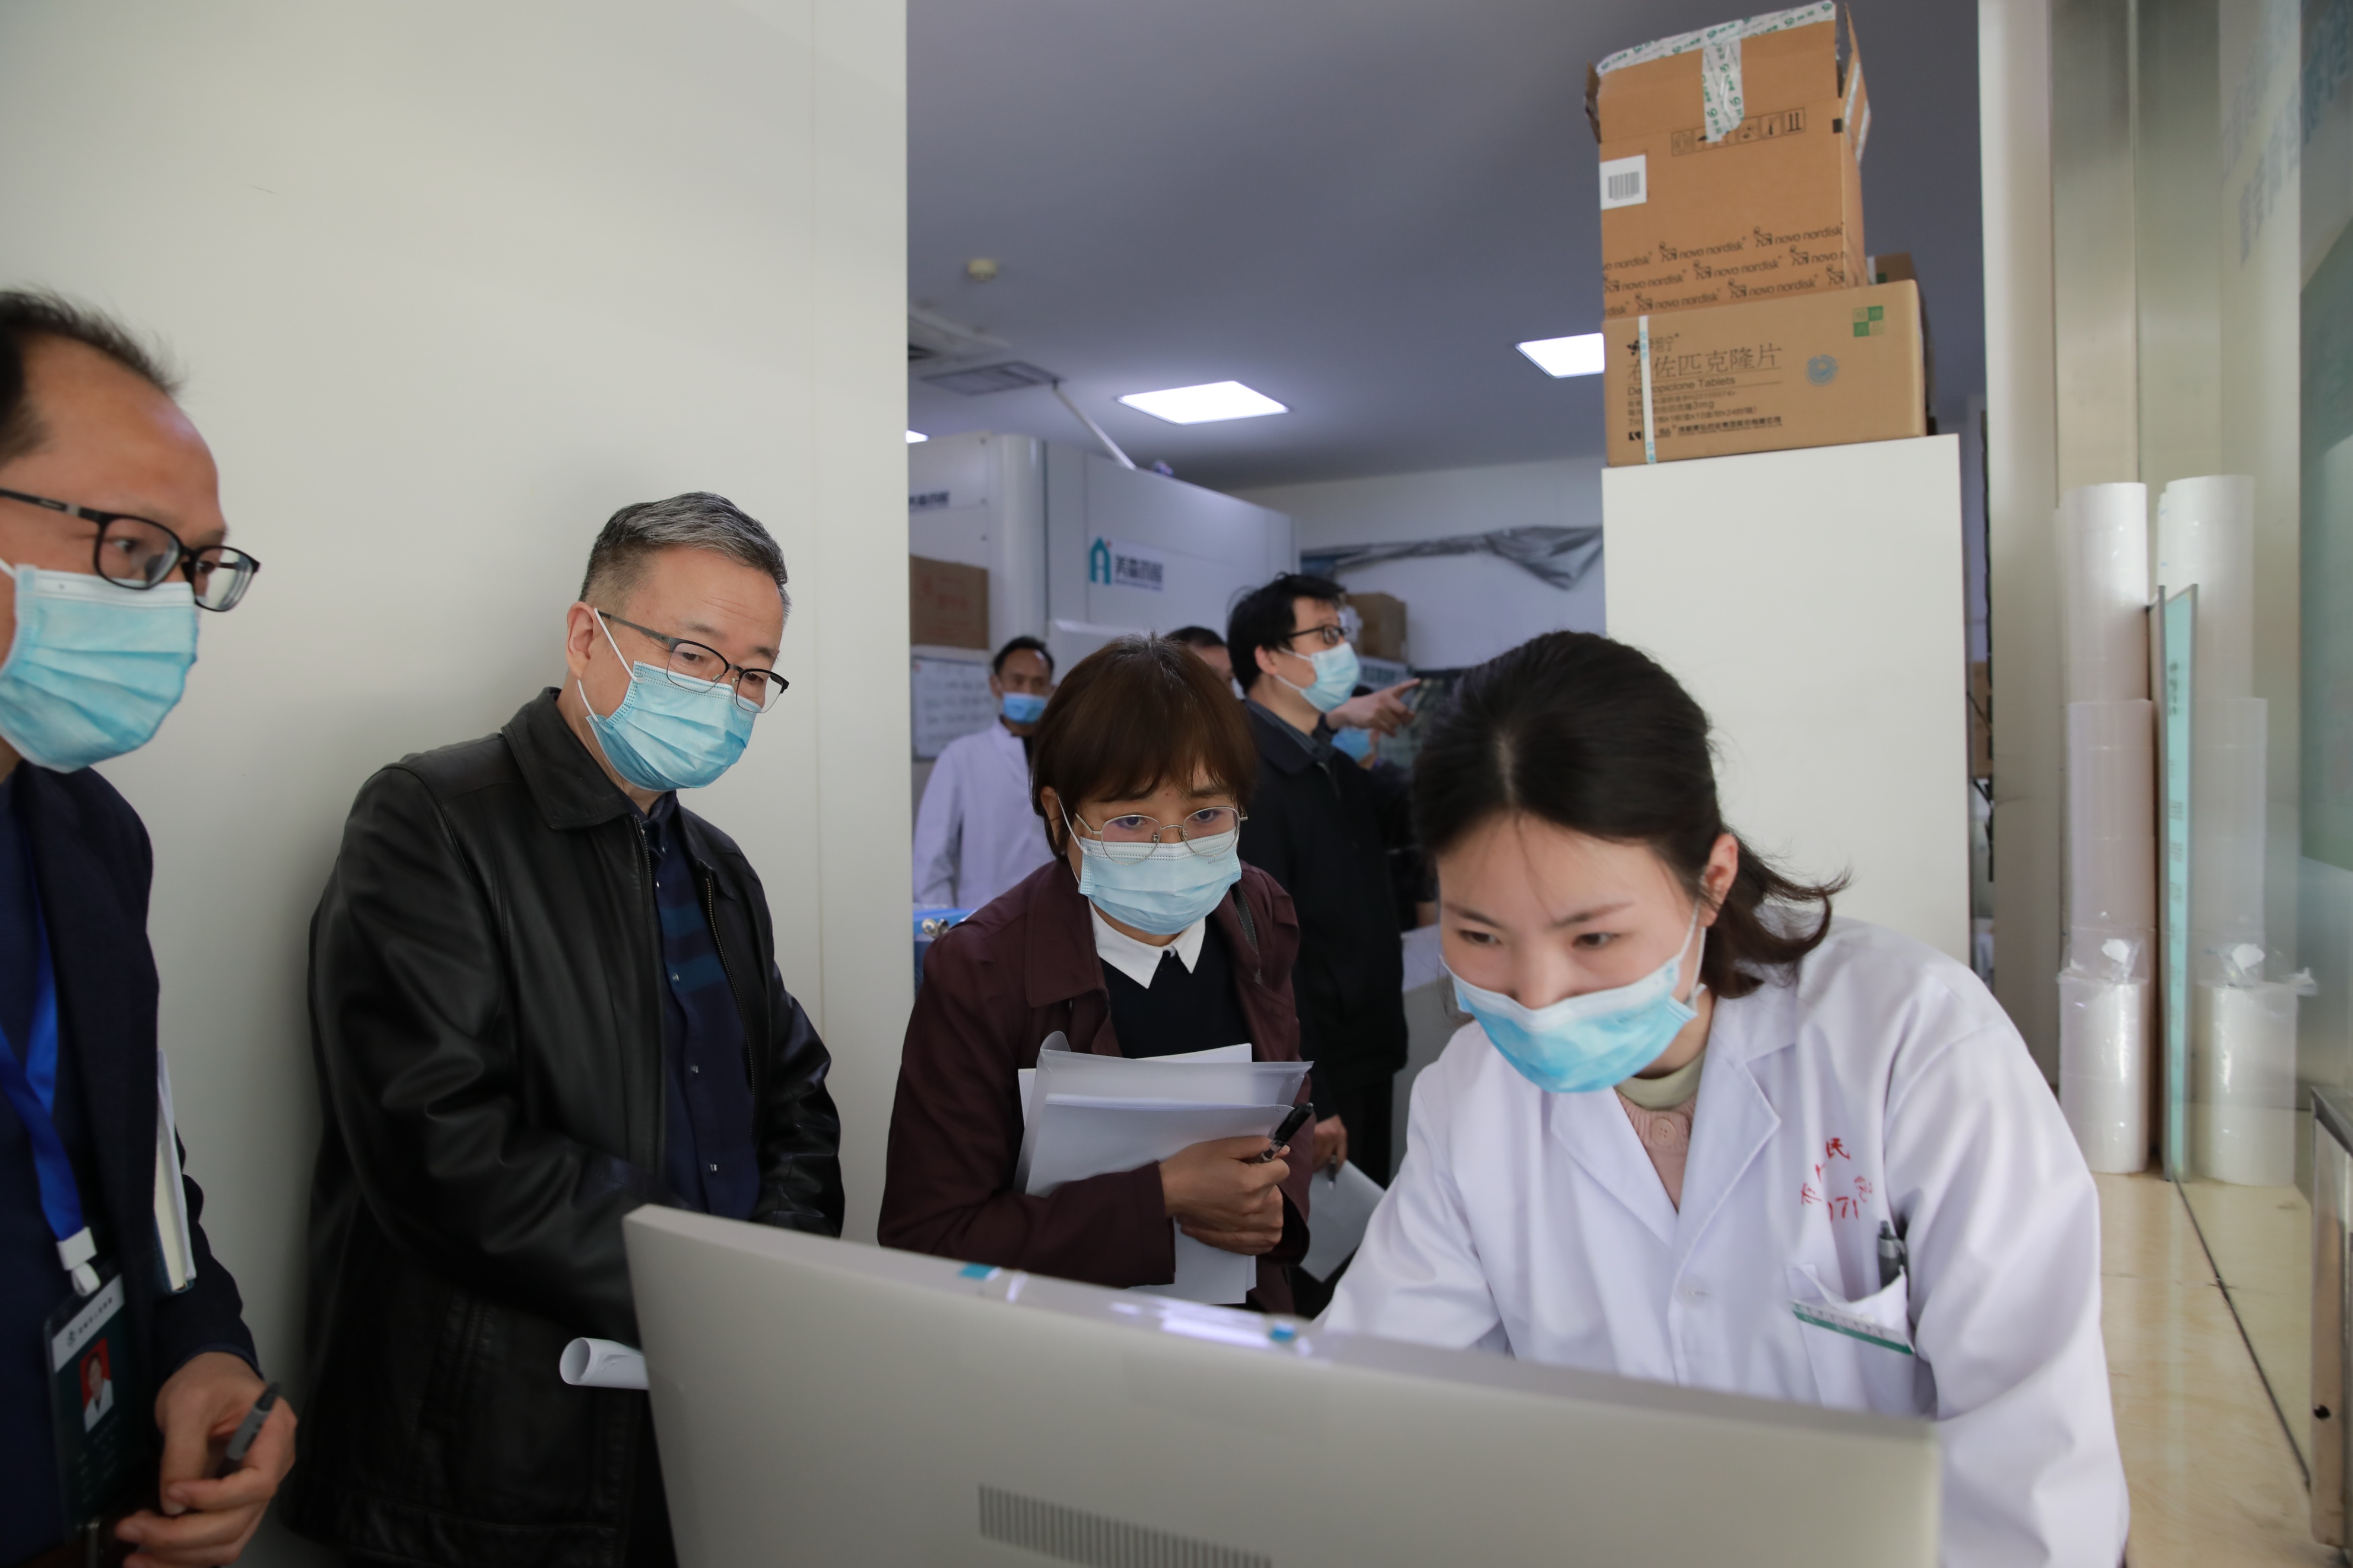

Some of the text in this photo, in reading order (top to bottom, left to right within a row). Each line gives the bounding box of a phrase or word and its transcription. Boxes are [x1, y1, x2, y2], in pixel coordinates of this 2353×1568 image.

[1775, 225, 1843, 244] novo nordisk
[1679, 241, 1744, 260] novo nordisk
[1811, 252, 1837, 263] novo
[1615, 256, 1650, 269] nordisk
[1713, 259, 1779, 277] novo nordisk
[1621, 274, 1684, 291] novo nordisk
[1748, 278, 1816, 297] novo nordisk
[1655, 292, 1718, 309] novo nordisk
[1698, 376, 1736, 388] Tablets
